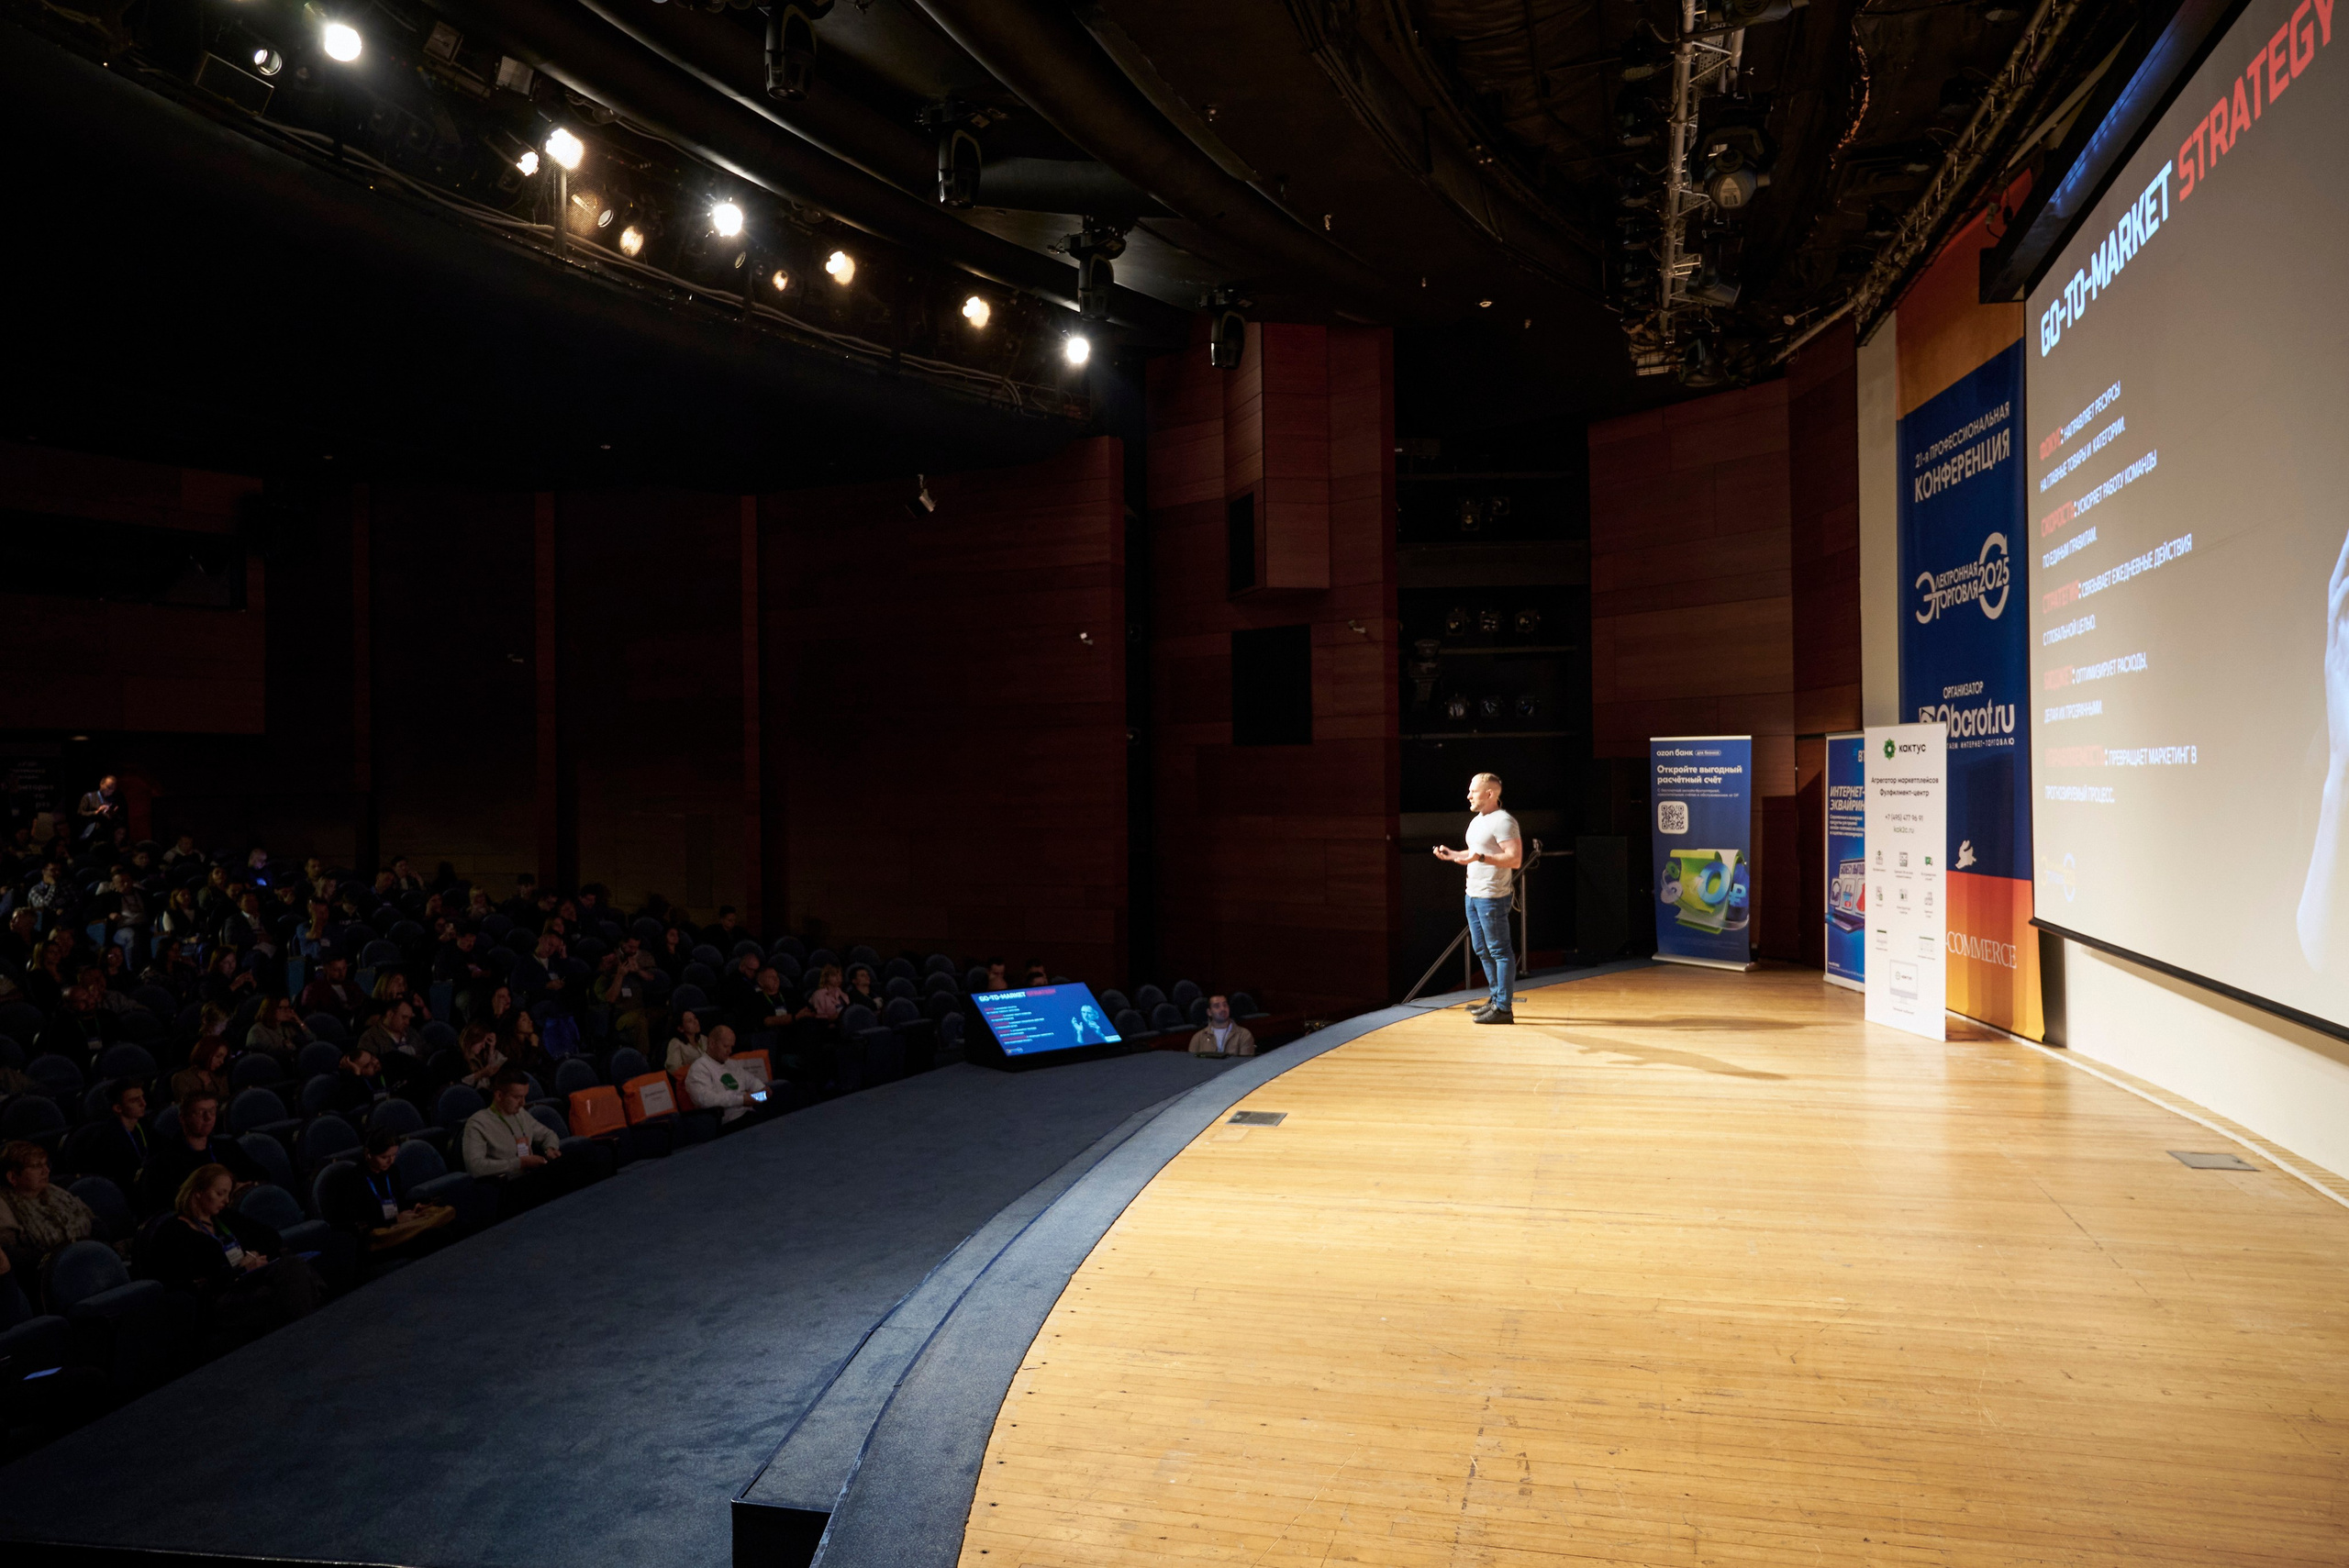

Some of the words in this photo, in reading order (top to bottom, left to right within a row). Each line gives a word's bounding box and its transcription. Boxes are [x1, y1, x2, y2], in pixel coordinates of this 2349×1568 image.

[2040, 160, 2173, 358] GO-TO-MARKET
[2178, 0, 2335, 203] STRATEGY
[2095, 381, 2121, 415] РЕСУРСЫ
[1930, 401, 2009, 460] ПРОФЕССИОНАЛЬНАЯ
[1915, 428, 2009, 503] КОНФЕРЕНЦИЯ
[2103, 471, 2123, 498] РАБОТУ
[2124, 449, 2157, 484] КОМАНДЫ
[2111, 550, 2154, 583] ЕЖЕДНЕВНЫЕ
[2154, 533, 2192, 569] ДЕЙСТВИЯ
[1977, 557, 2009, 595] 2025
[1943, 681, 1984, 699] ОРГАНИЗАТОР
[1675, 749, 1694, 757] банк
[1898, 742, 1927, 754] кактус
[2148, 745, 2190, 764] МАРКЕТИНГ
[2191, 745, 2198, 764] В
[1656, 764, 1698, 775] Откройте
[1698, 764, 1742, 775] выгодный
[1656, 775, 1702, 784] расчётный
[1703, 775, 1722, 784] счёт
[1871, 776, 1897, 784] Агрегатор
[1898, 776, 1939, 784] маркетплейсов
[1879, 788, 1930, 797] Фулфилмент-центр
[978, 991, 1027, 1003] GO-TO-MARKET
